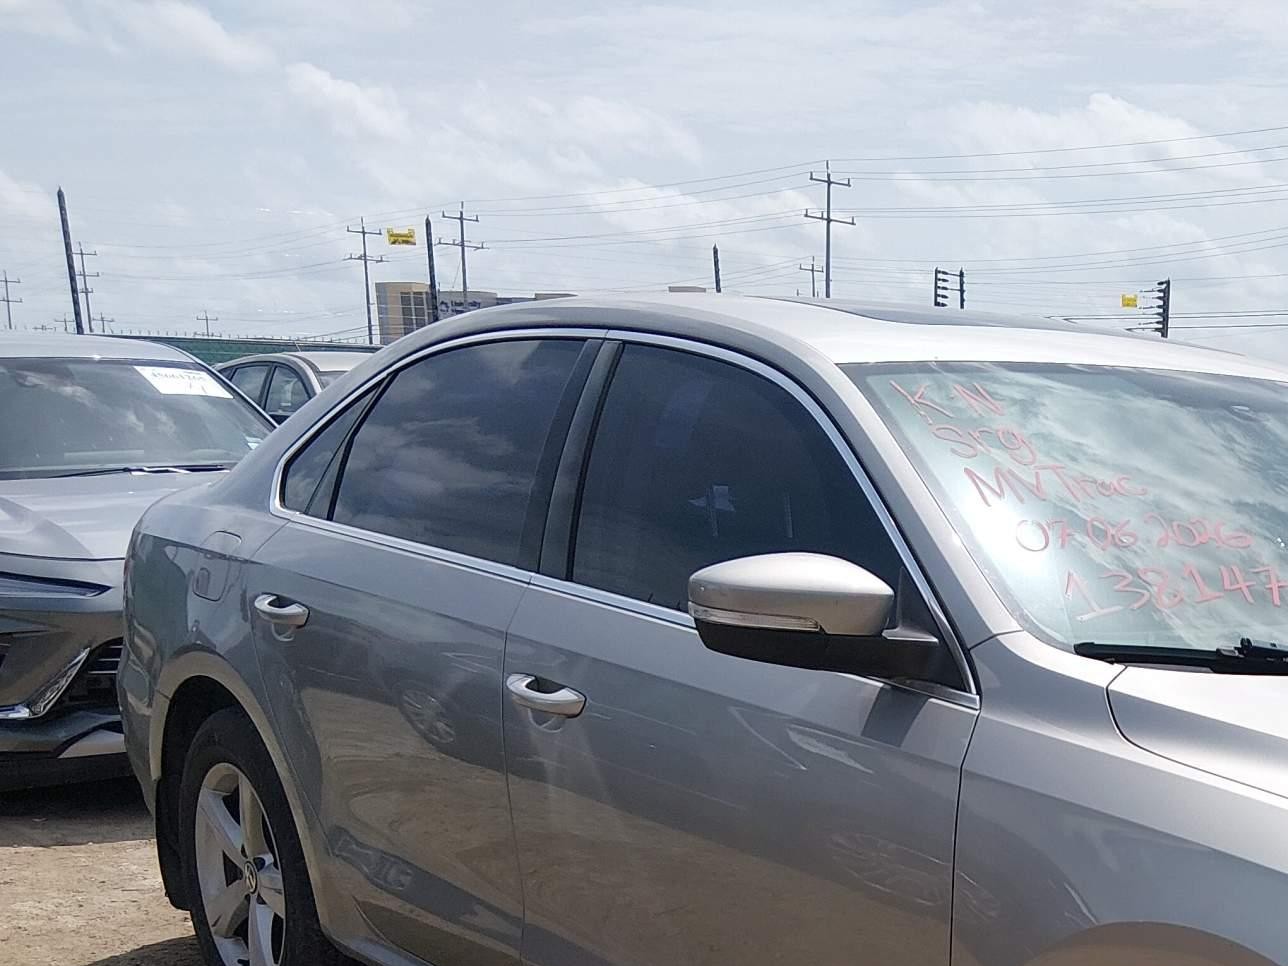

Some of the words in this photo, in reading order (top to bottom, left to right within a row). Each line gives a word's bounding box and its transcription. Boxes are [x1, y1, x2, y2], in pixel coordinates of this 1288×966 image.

[1015, 518, 1072, 552] 07
[1086, 515, 1138, 551] 06
[1144, 512, 1254, 549] 2026
